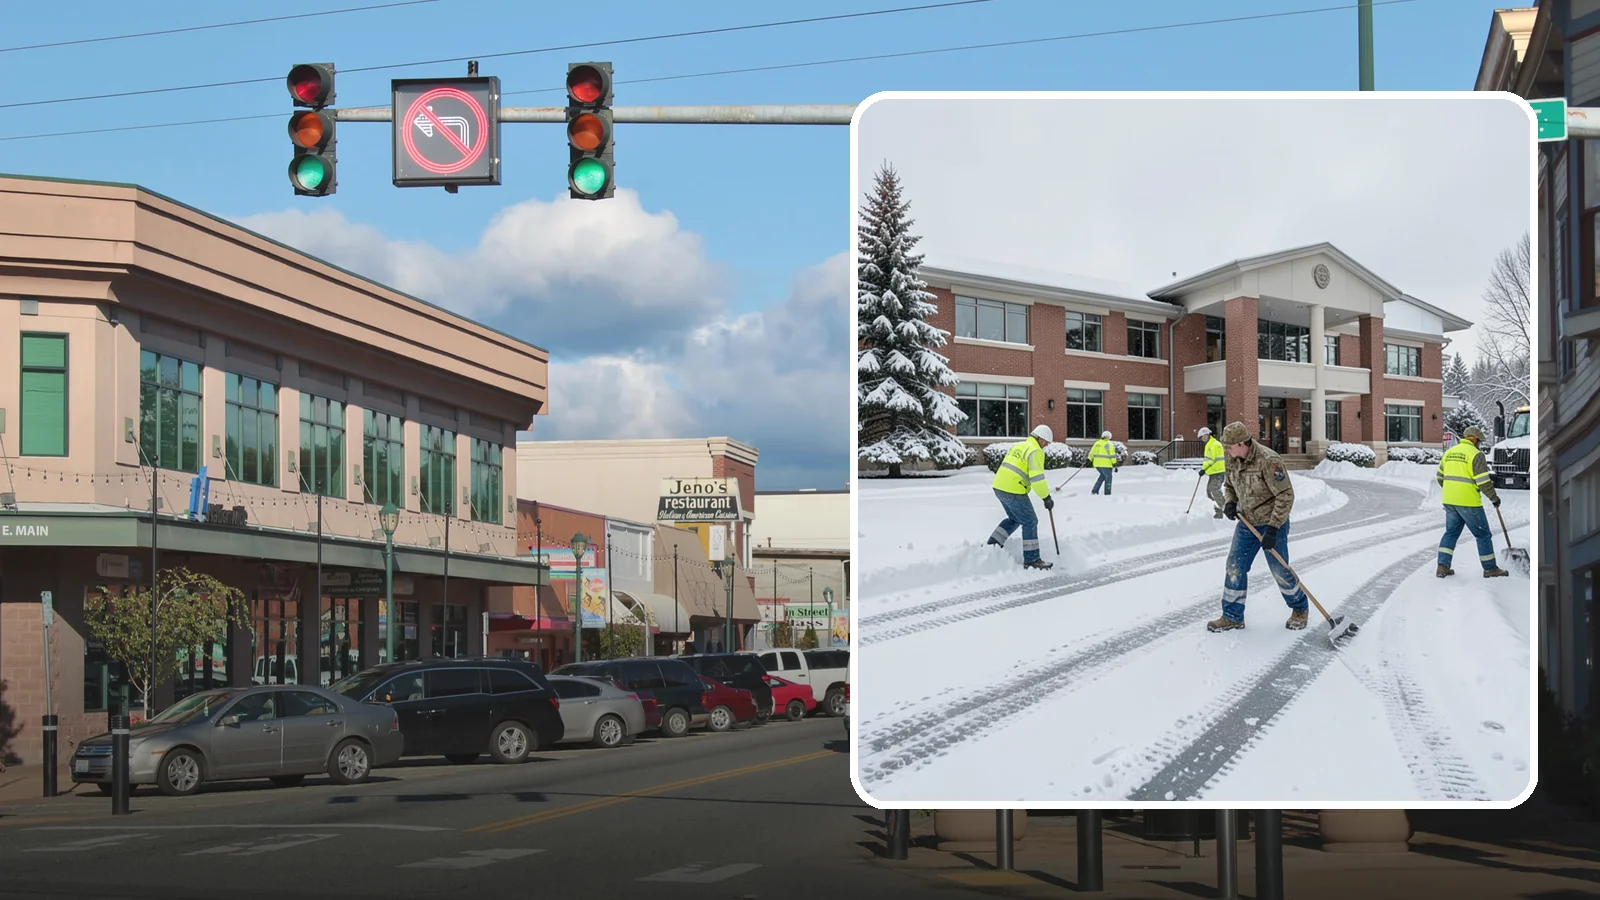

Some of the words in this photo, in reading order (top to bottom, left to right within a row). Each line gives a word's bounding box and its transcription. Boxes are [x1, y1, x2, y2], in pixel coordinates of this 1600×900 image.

[669, 480, 728, 494] Jeno's
[665, 496, 731, 509] restaurant
[658, 510, 682, 520] Italian
[686, 509, 715, 519] American
[715, 509, 738, 520] Cuisine
[2, 525, 13, 536] E.
[15, 525, 49, 536] MAIN
[786, 607, 795, 617] in
[797, 607, 828, 617] Street
[791, 619, 824, 627] lass
